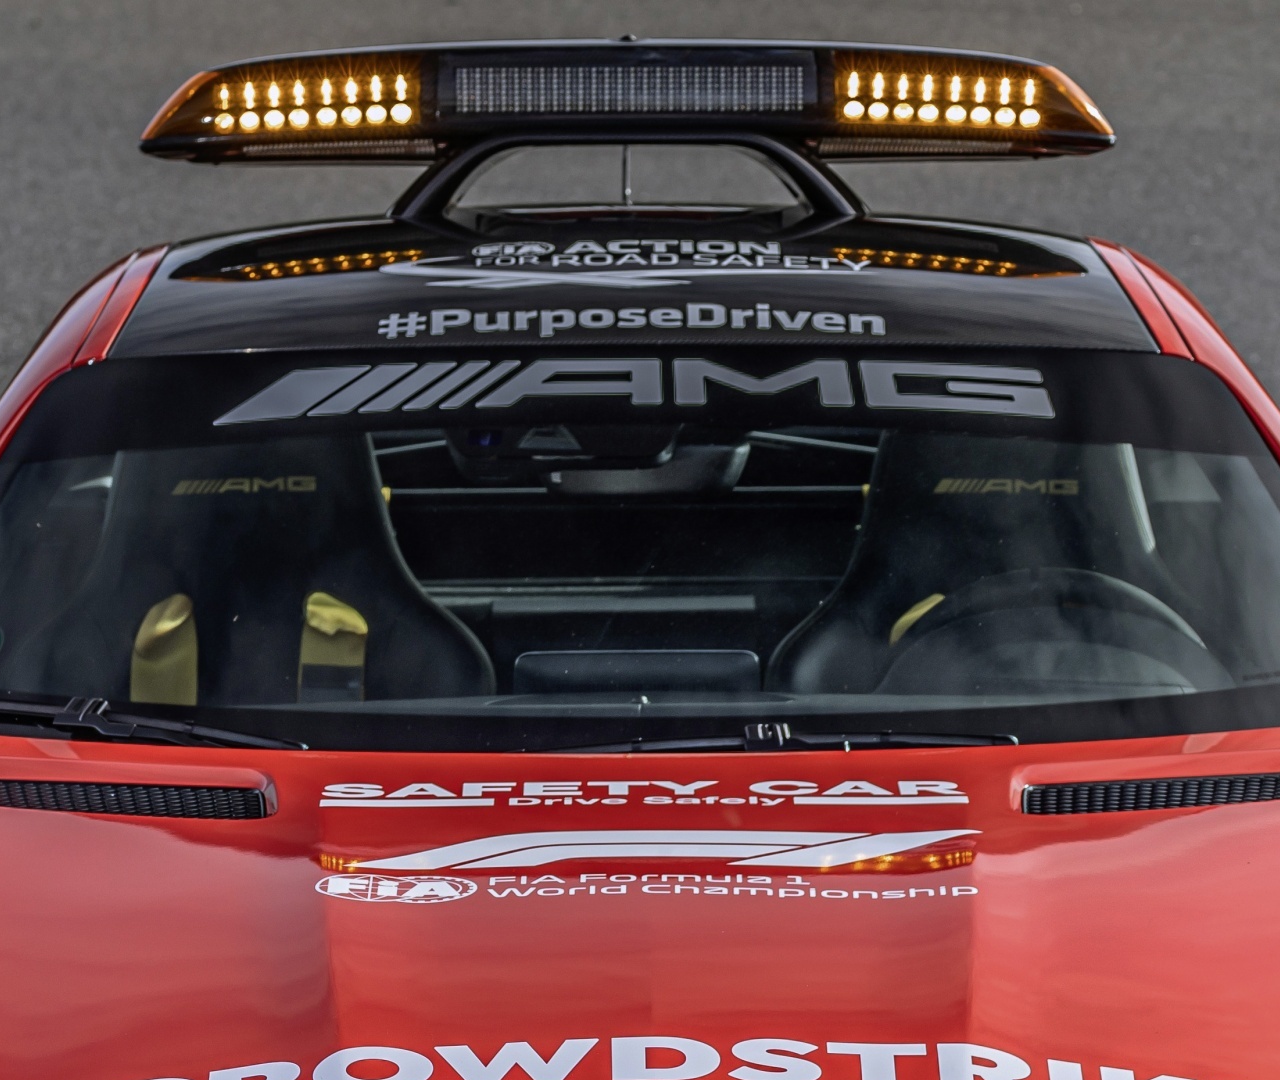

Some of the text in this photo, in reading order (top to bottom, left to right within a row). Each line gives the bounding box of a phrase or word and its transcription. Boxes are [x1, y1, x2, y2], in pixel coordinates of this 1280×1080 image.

[563, 239, 781, 256] ACTION
[475, 253, 871, 272] FOR ROAD SAFETY
[378, 303, 887, 338] #PurposeDriven
[322, 780, 968, 798] SAFETY CAR
[508, 795, 786, 806] Drive Safely
[488, 873, 811, 886] FIA Formula 1
[486, 885, 979, 900] World Championship
